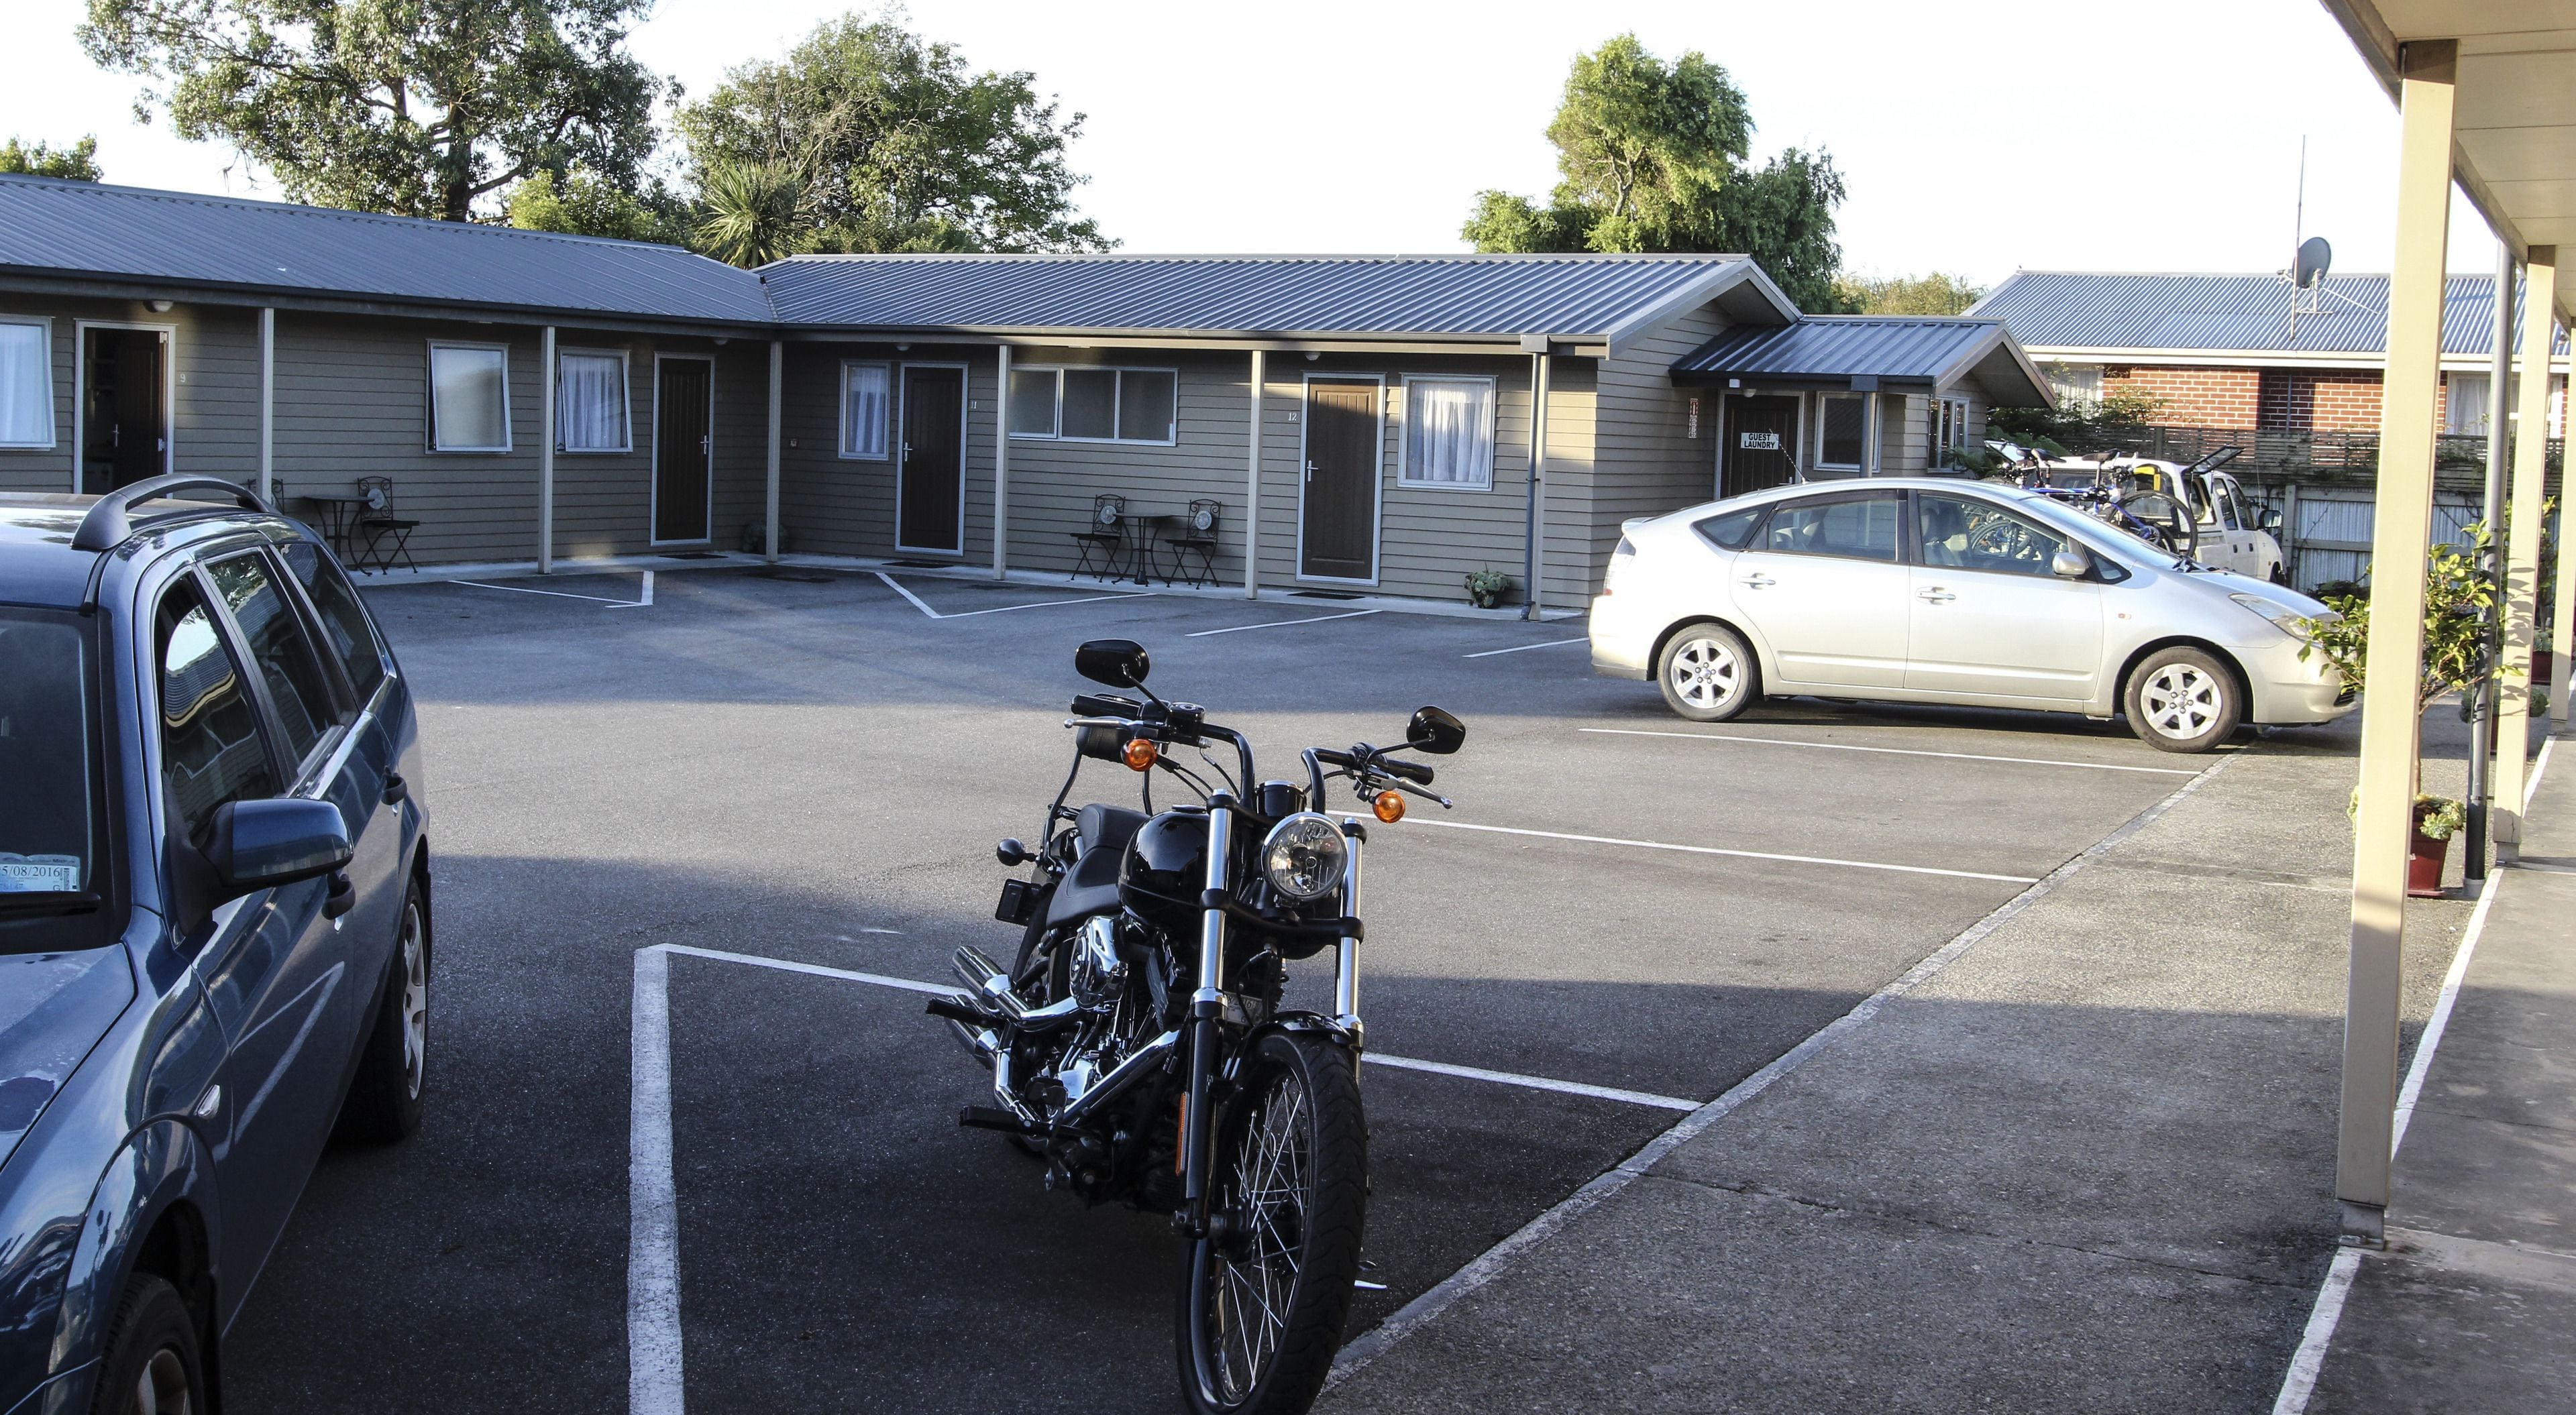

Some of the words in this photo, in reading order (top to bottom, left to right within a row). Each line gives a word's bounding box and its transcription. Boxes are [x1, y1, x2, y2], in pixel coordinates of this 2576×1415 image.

[180, 373, 186, 382] 9
[971, 401, 977, 409] 11
[1288, 412, 1297, 421] 12
[1749, 433, 1771, 441] GUEST
[1744, 440, 1775, 449] LAUNDRY
[0, 866, 60, 876] 5/08/2016
